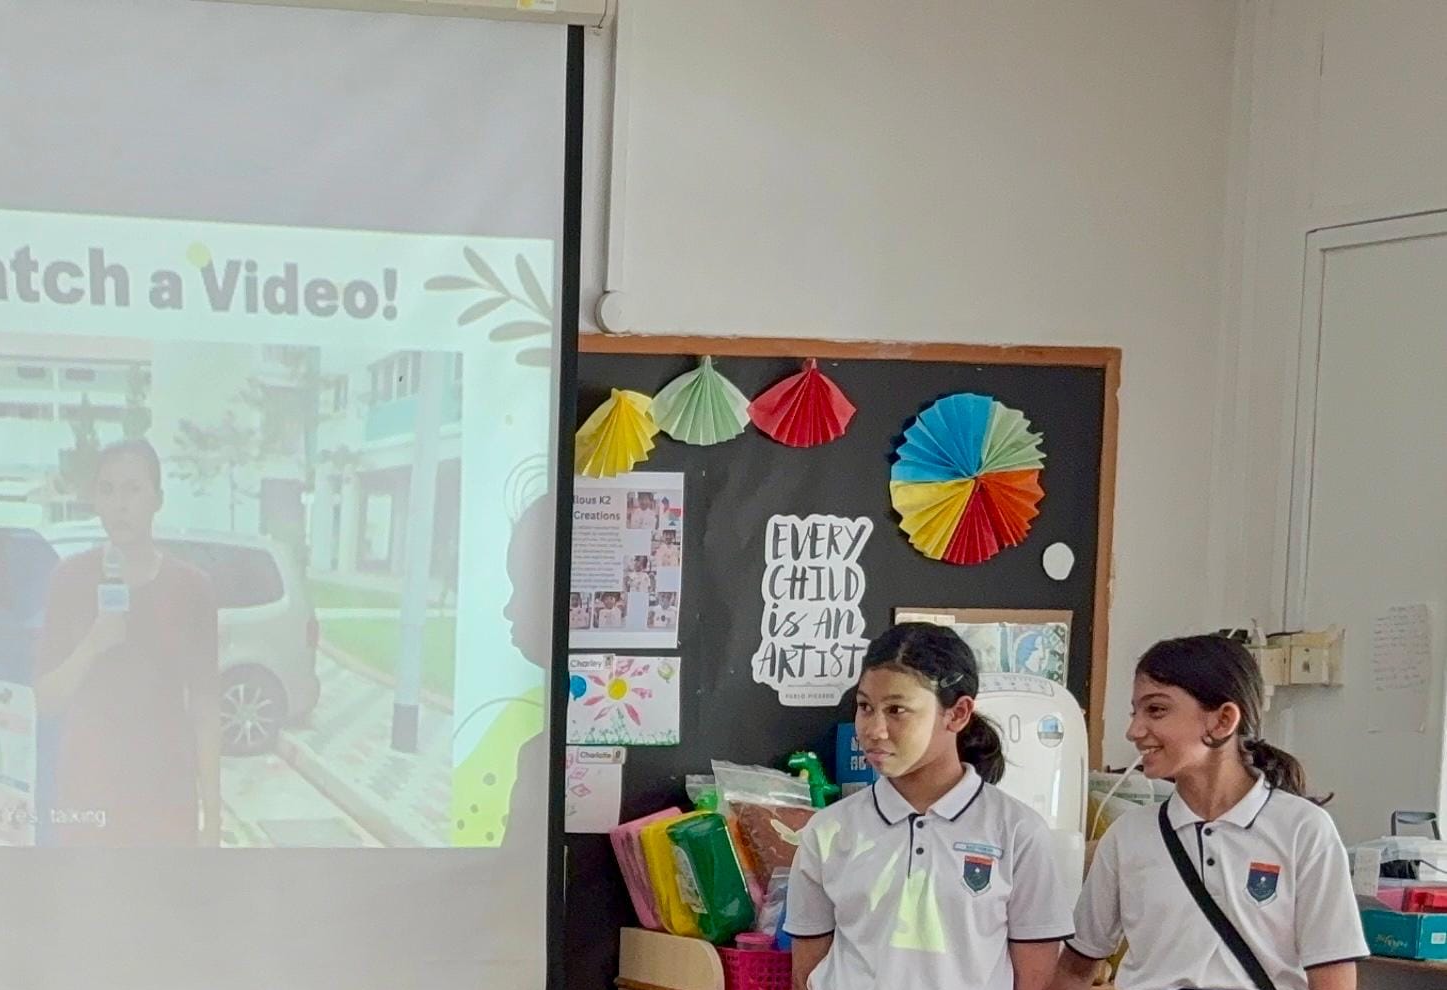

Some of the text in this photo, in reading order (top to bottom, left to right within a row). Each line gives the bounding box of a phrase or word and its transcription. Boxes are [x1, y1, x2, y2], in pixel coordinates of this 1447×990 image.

[150, 270, 184, 310] a
[200, 262, 399, 319] Video!
[574, 510, 620, 520] Creations
[600, 496, 611, 504] K2
[772, 522, 867, 561] EVERY
[769, 564, 859, 601] CHILD
[759, 642, 865, 683] ARTIST
